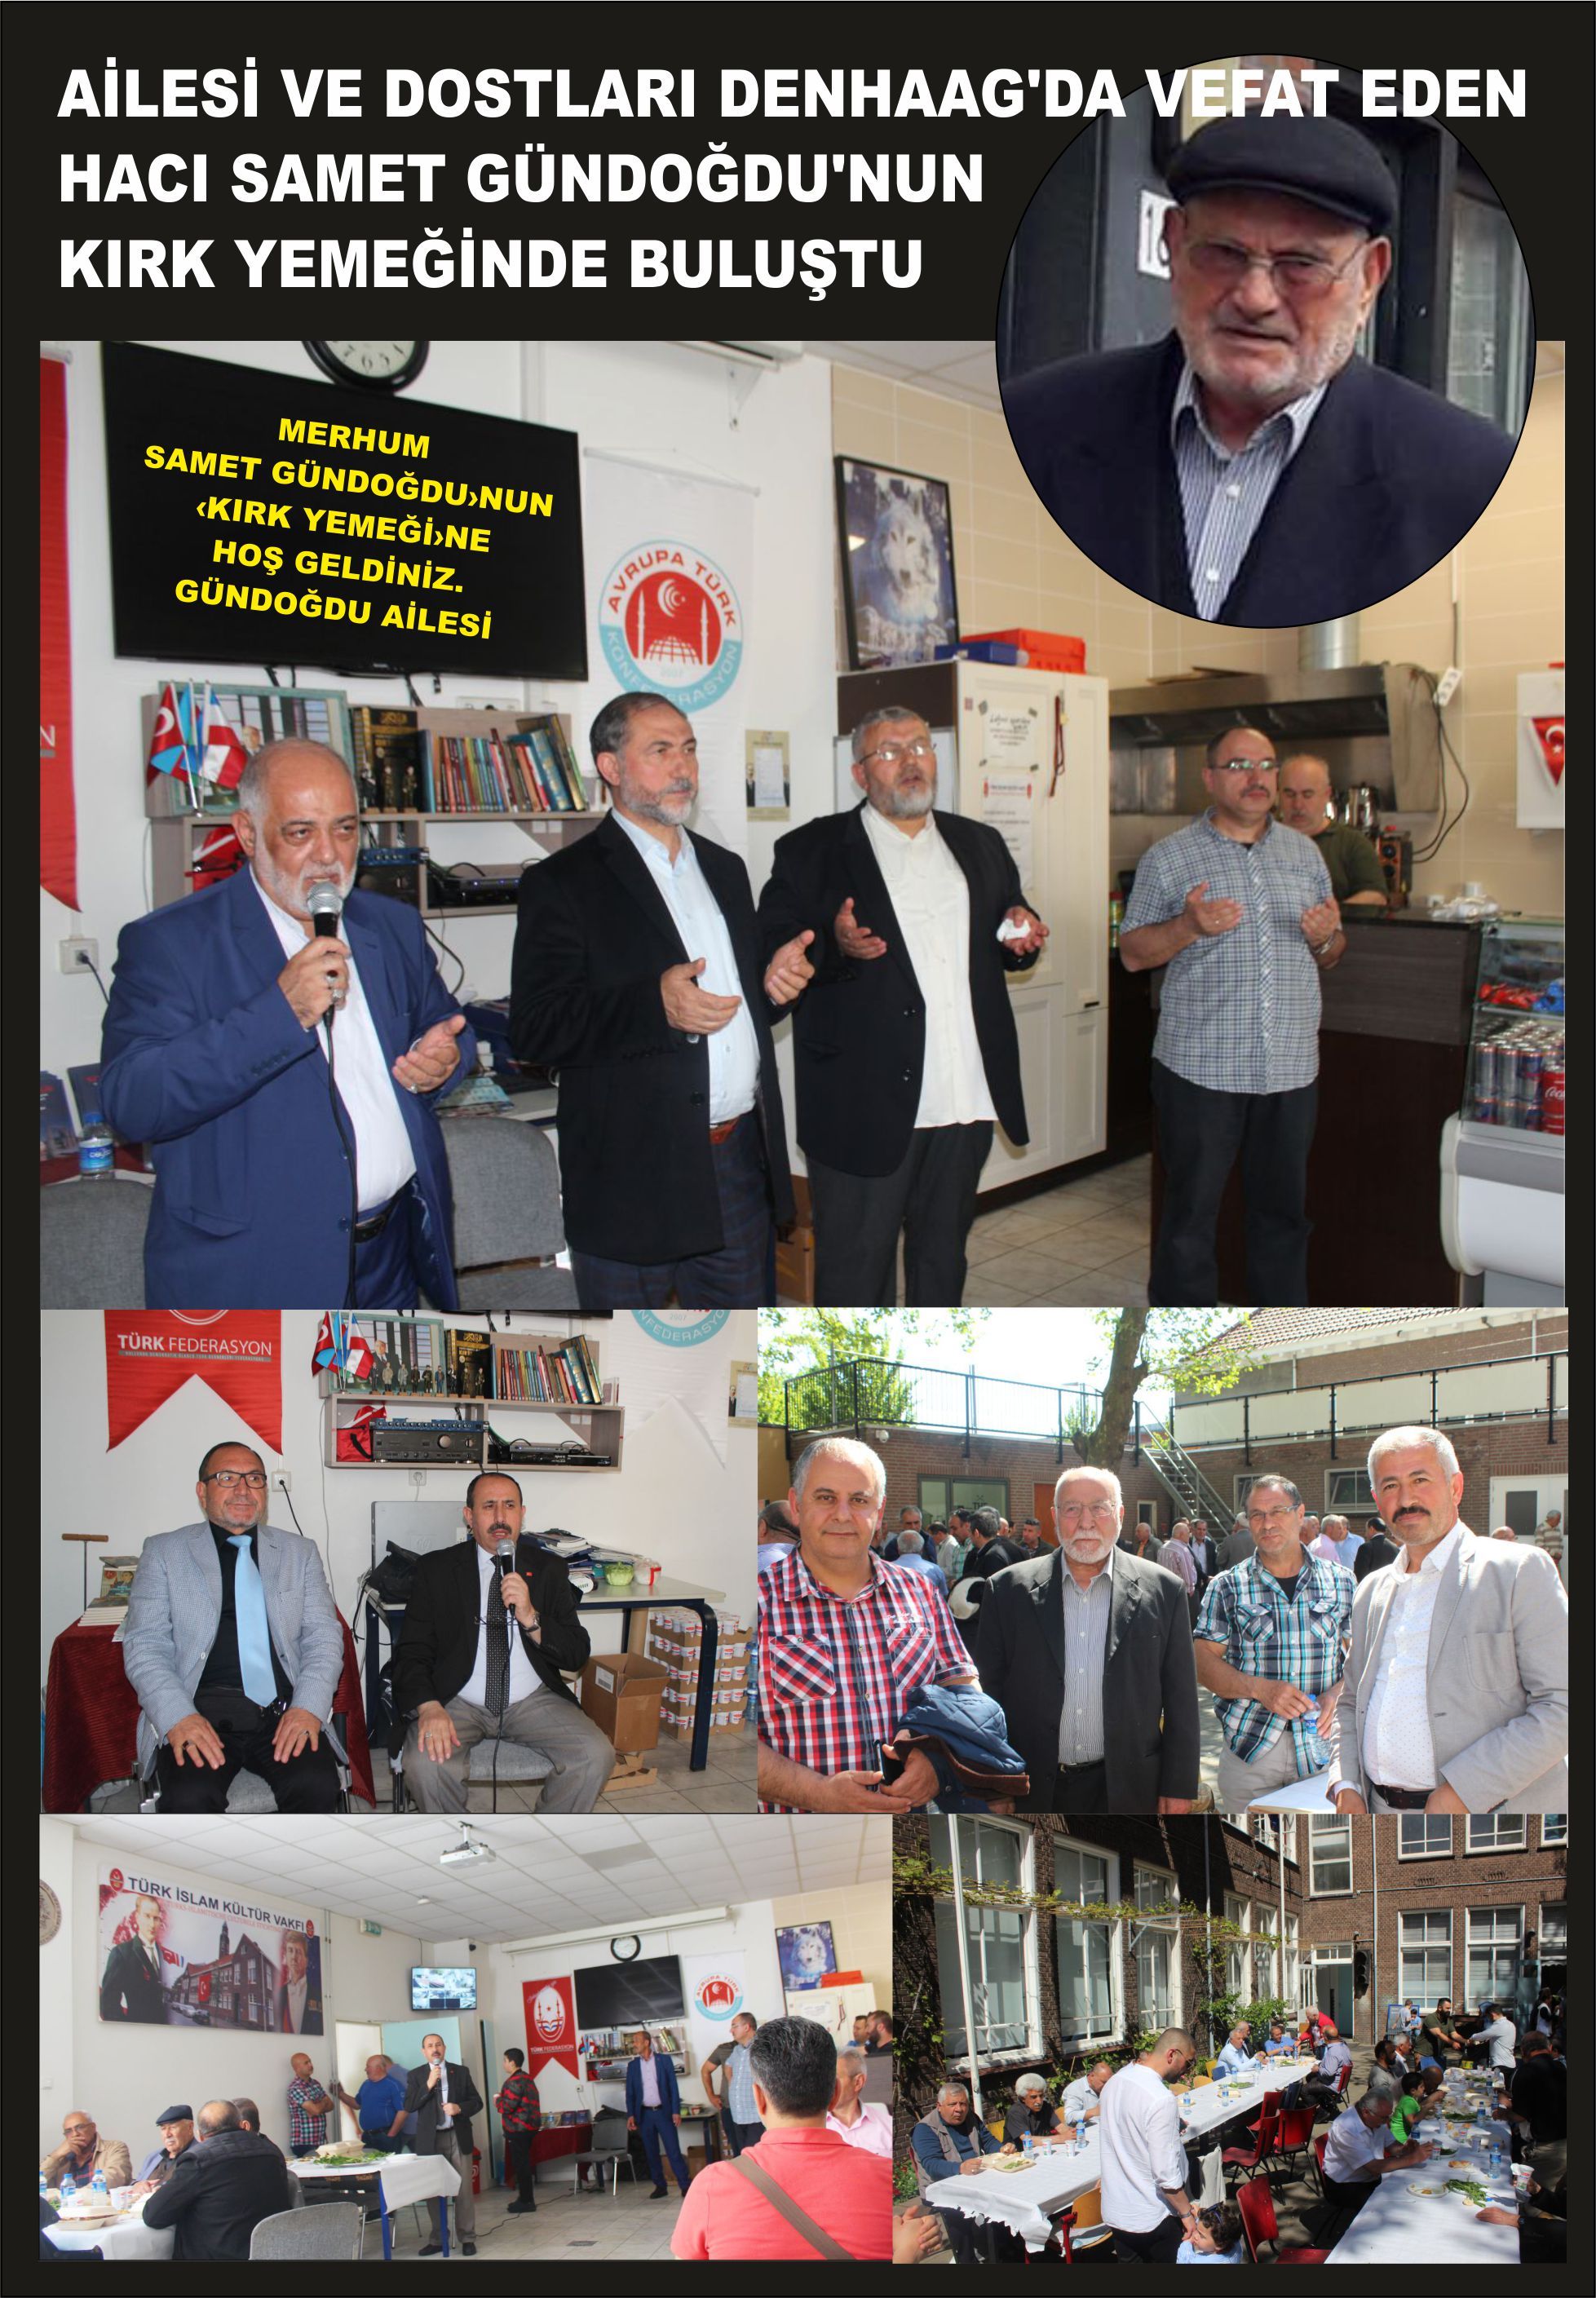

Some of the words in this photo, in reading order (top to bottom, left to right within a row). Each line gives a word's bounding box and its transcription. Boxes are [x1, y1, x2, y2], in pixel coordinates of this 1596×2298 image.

[608, 550, 684, 614] AVRUPA
[694, 562, 736, 626] TÜRK
[669, 1313, 687, 1322] 2007
[117, 1332, 165, 1351] TÜRK
[169, 1337, 272, 1357] FEDERASYON
[128, 1876, 172, 1899] TÜRK
[175, 1887, 219, 1911] İSLAM
[223, 1900, 272, 1925] KÜLTÜR
[272, 1914, 305, 1932] VAKFI
